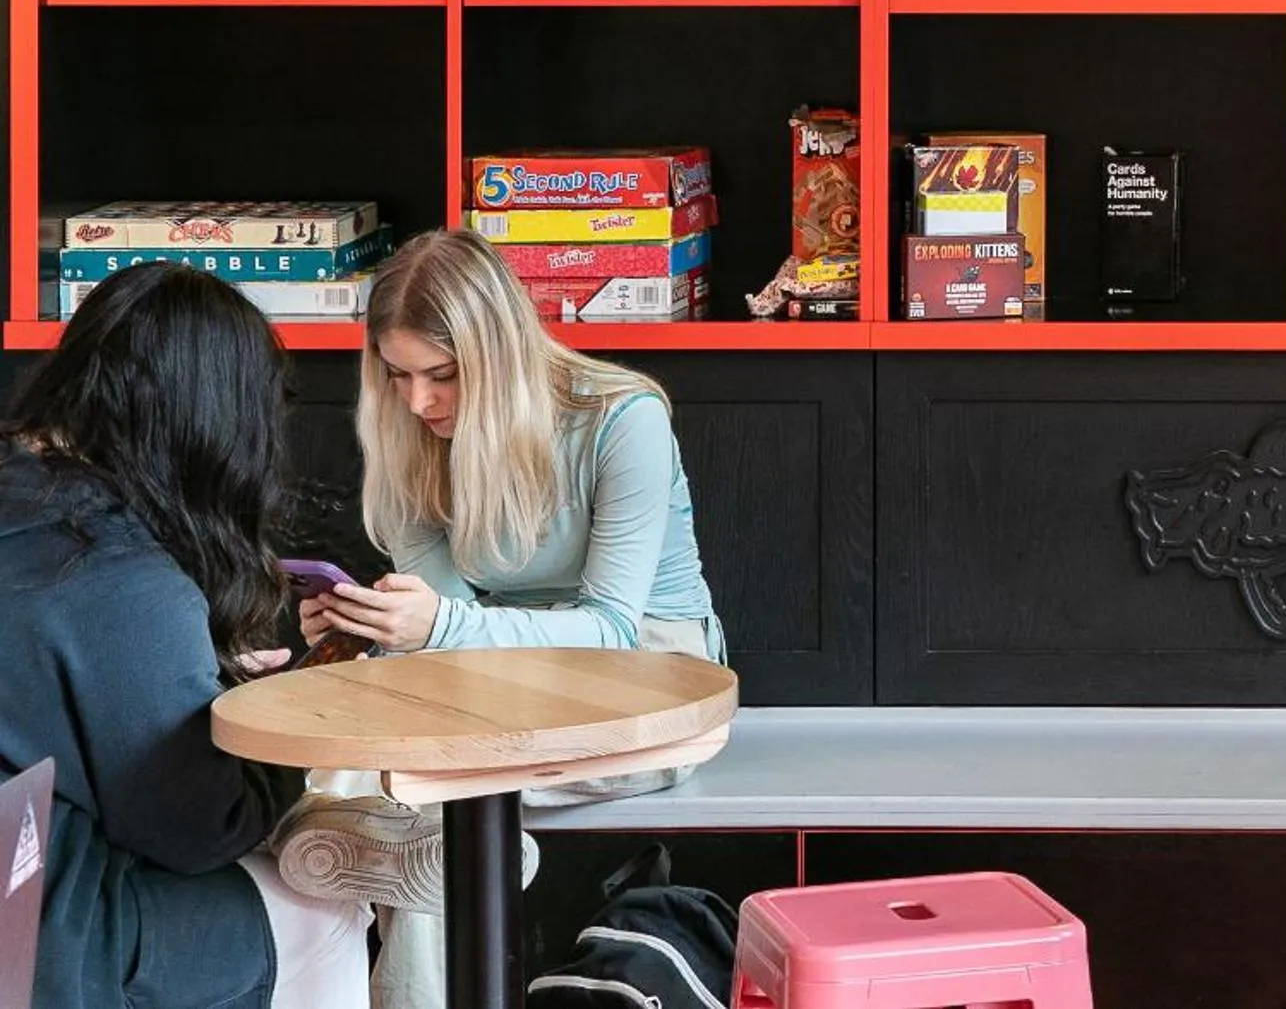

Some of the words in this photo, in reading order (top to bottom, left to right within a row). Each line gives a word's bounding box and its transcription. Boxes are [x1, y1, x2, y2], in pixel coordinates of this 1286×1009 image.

[1107, 162, 1146, 175] Cards
[482, 165, 509, 205] 5
[511, 165, 588, 192] SECOND
[589, 171, 638, 194] RULE
[1107, 175, 1156, 189] Against
[1107, 187, 1168, 201] Humanity
[590, 213, 636, 232] Twister
[75, 224, 114, 242] Retro
[548, 249, 596, 269] Twister
[915, 244, 971, 260] EXPLODING
[974, 243, 1018, 258] KITTENS
[107, 257, 290, 271] SCABBLE
